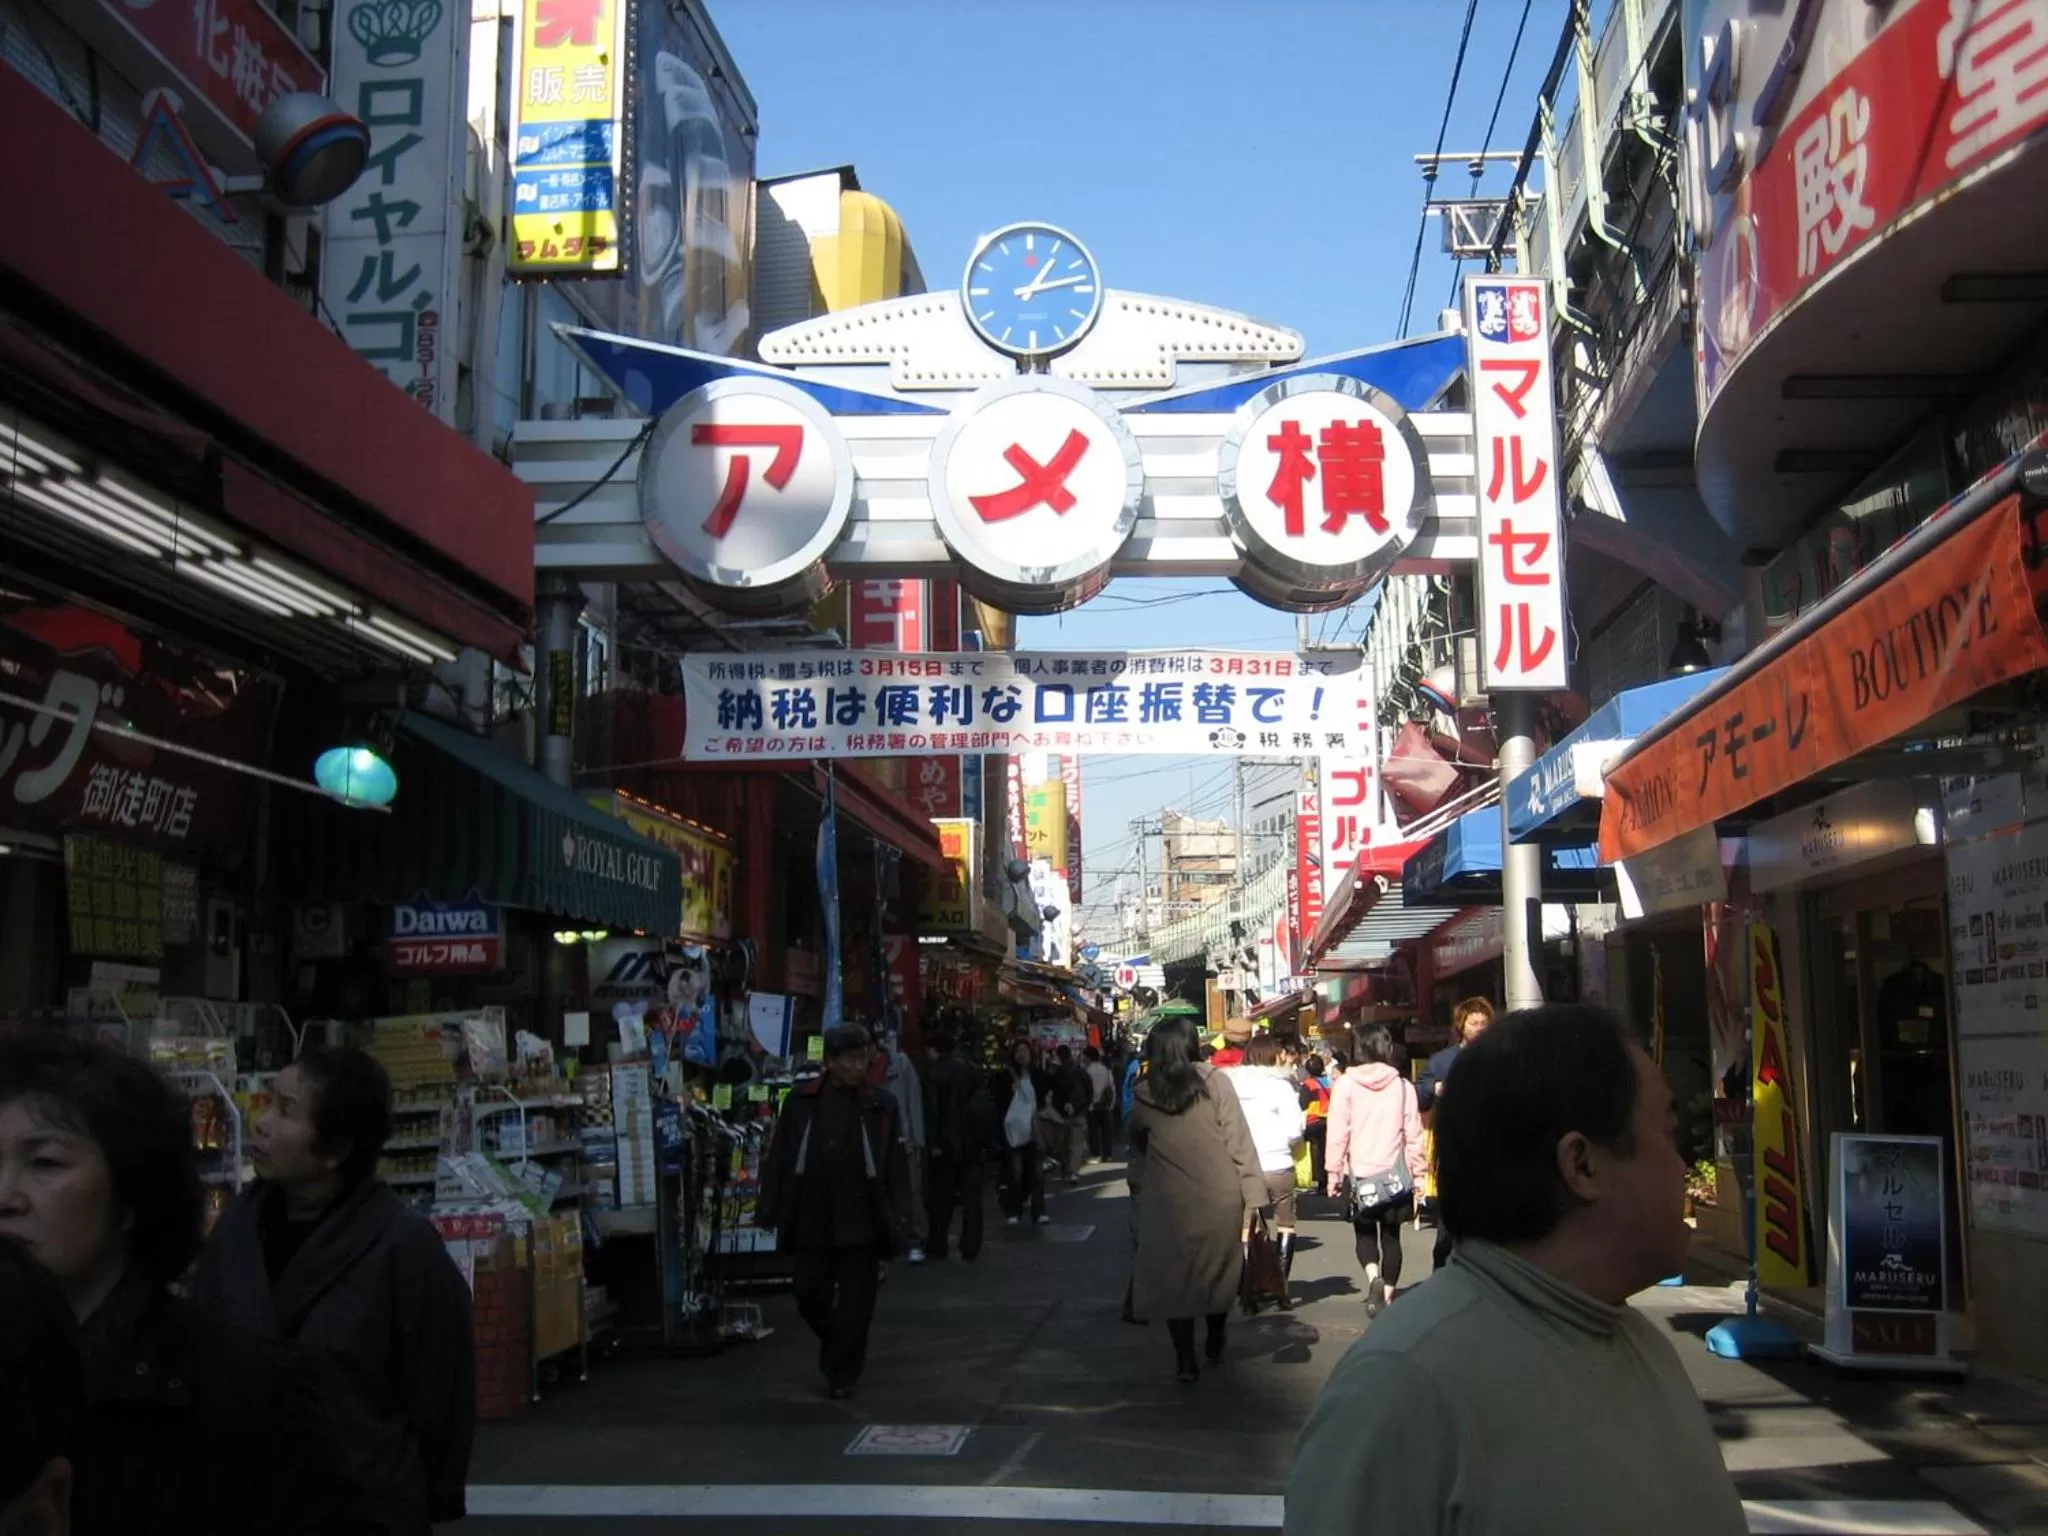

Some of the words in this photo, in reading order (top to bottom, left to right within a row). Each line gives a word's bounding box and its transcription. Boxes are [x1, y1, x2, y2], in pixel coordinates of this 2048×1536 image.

[529, 63, 609, 105] 販売
[345, 78, 433, 394] ロイヤルゴ
[516, 236, 608, 260] ラムタラ
[692, 420, 1389, 537] アメ横
[1480, 359, 1556, 675] マルセル
[1693, 683, 1811, 799] アモーレ
[80, 761, 199, 841] 御徒町店
[577, 835, 625, 881] ROYAL
[626, 850, 663, 892] GOLF
[393, 906, 488, 935] Daiwa
[1882, 1143, 1908, 1249] マルセル
